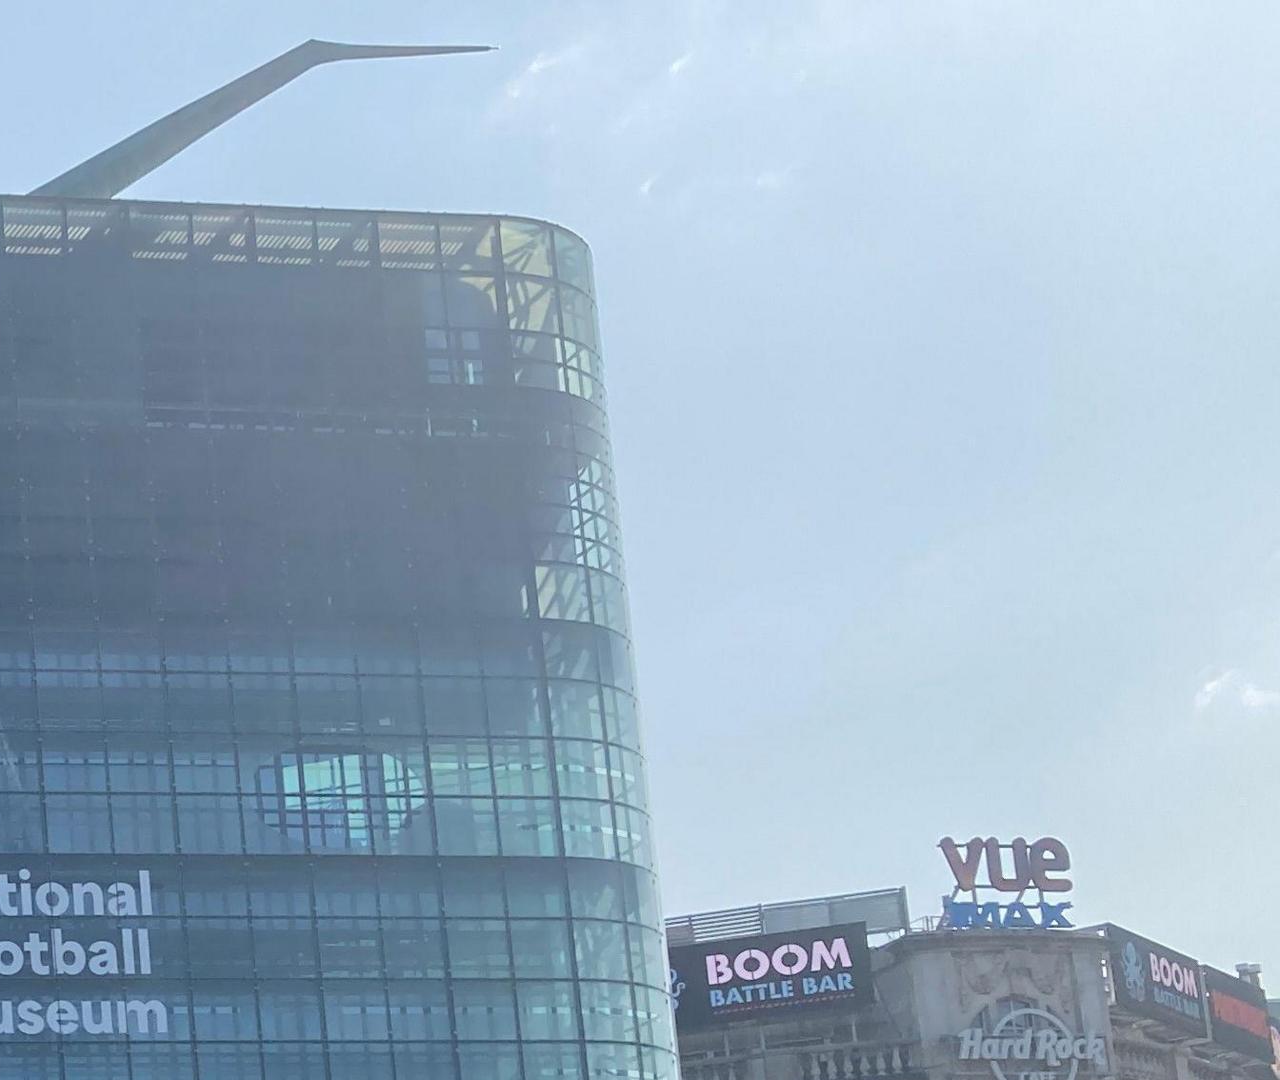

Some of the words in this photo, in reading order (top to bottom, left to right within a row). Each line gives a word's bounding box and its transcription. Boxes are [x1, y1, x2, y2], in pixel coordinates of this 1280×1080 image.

[705, 937, 853, 986] BOOM
[1149, 952, 1198, 998] BOOM
[710, 980, 794, 1007] BATTLE
[802, 973, 855, 995] BAR
[958, 1028, 1033, 1060] Hard
[1034, 1029, 1106, 1067] Rock
